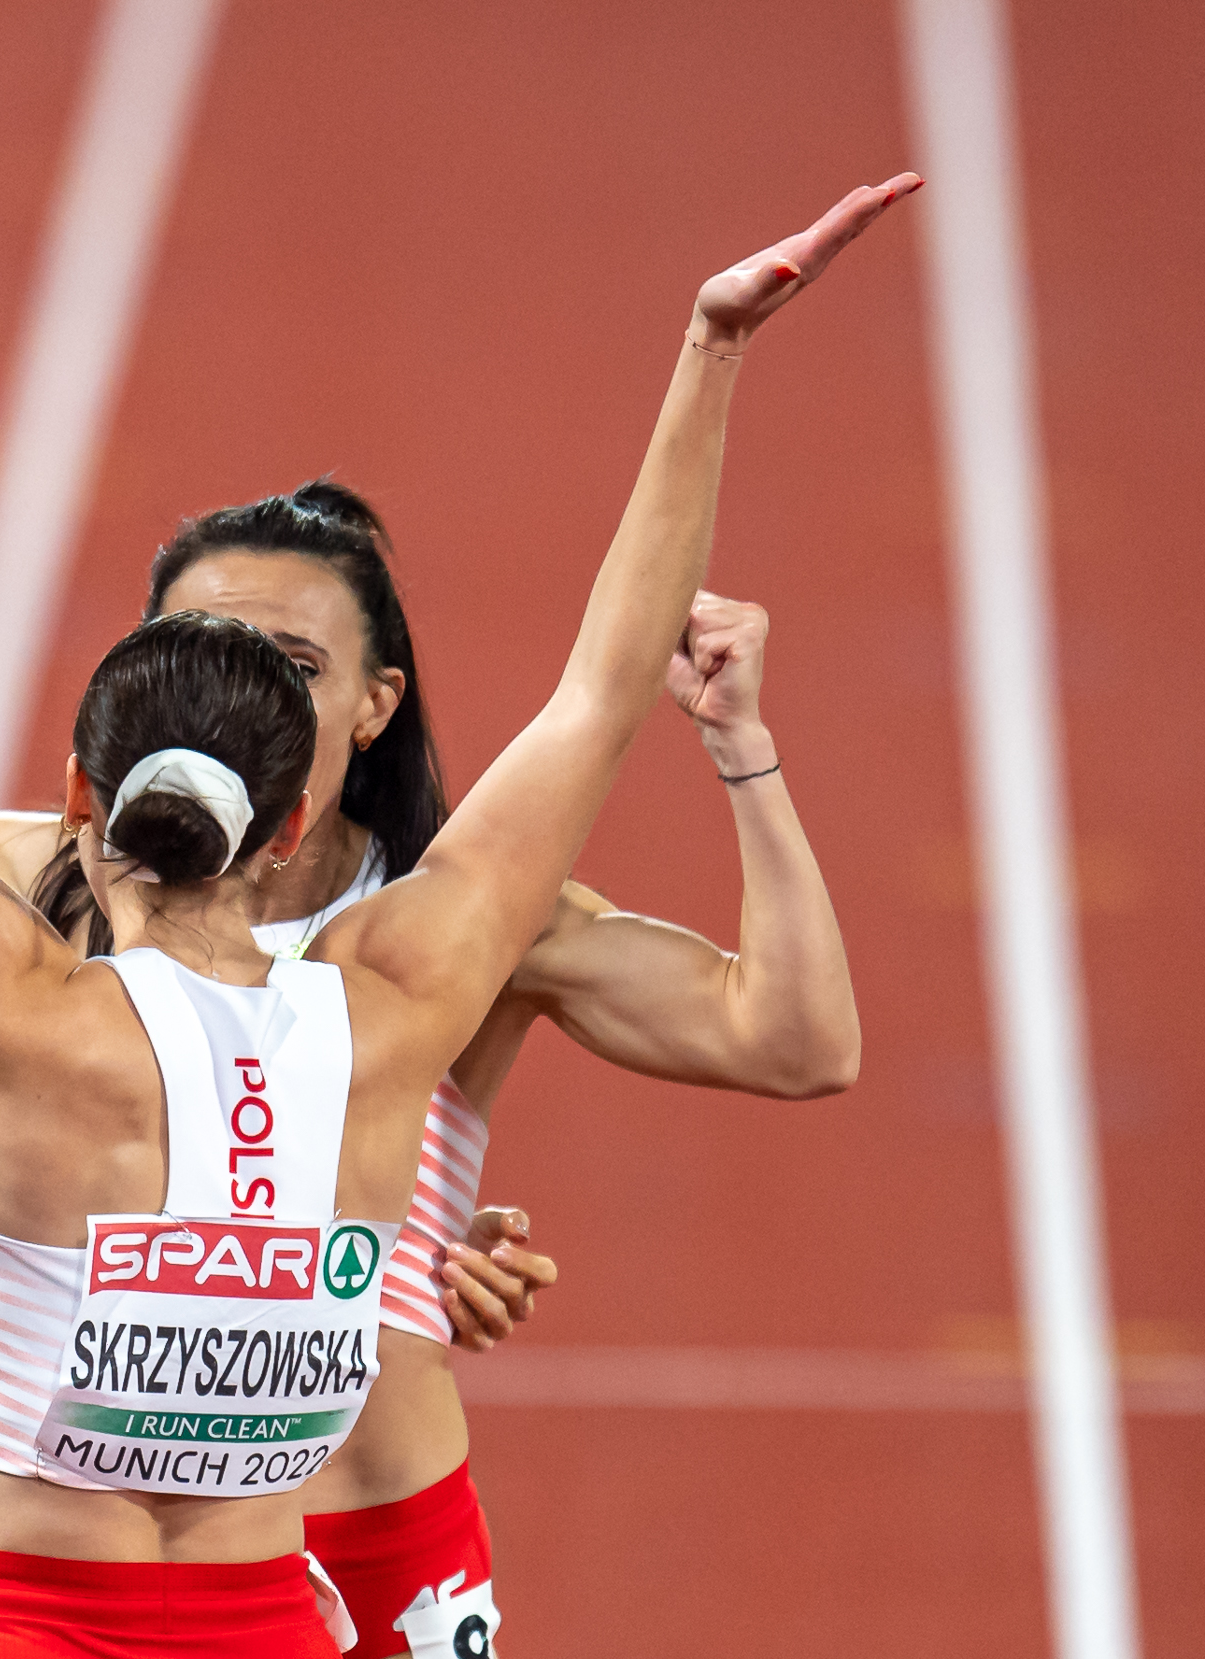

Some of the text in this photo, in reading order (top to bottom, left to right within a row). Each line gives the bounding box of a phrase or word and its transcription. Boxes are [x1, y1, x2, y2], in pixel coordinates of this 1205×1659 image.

[229, 1057, 276, 1220] POLS
[98, 1231, 314, 1290] SPAR
[70, 1319, 367, 1399] SKRZYSZOWSKA
[124, 1413, 135, 1433] I
[141, 1415, 199, 1437] RUN
[54, 1433, 330, 1486] MUNICH 2022
